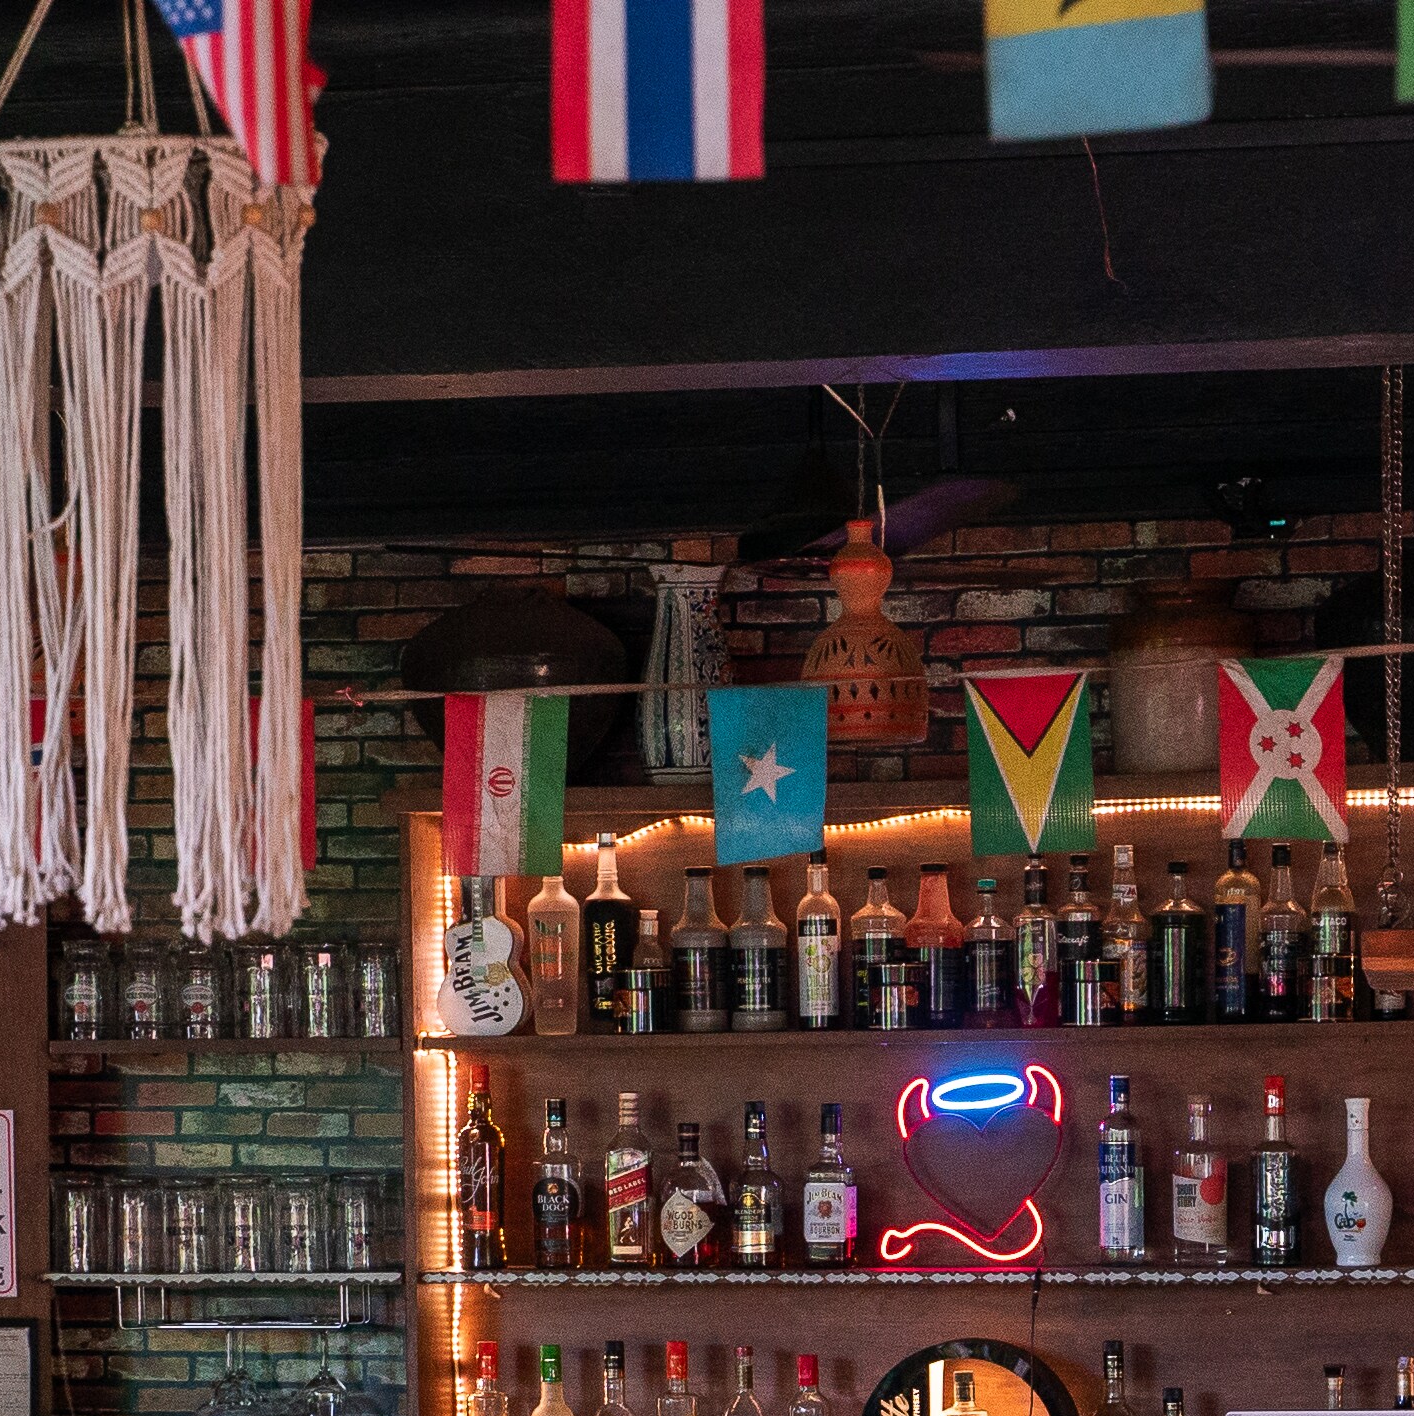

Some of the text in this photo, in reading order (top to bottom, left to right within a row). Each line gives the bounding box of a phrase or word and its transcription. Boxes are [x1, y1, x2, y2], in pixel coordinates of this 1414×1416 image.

[453, 934, 504, 1024] JIM BEAM
[608, 1177, 646, 1196] RED LABEL
[537, 1194, 570, 1204] BLACK
[1105, 1193, 1128, 1205] GIN
[542, 1203, 565, 1212] DOG
[667, 1210, 694, 1220] WOOD
[673, 1220, 703, 1231] BURNS
